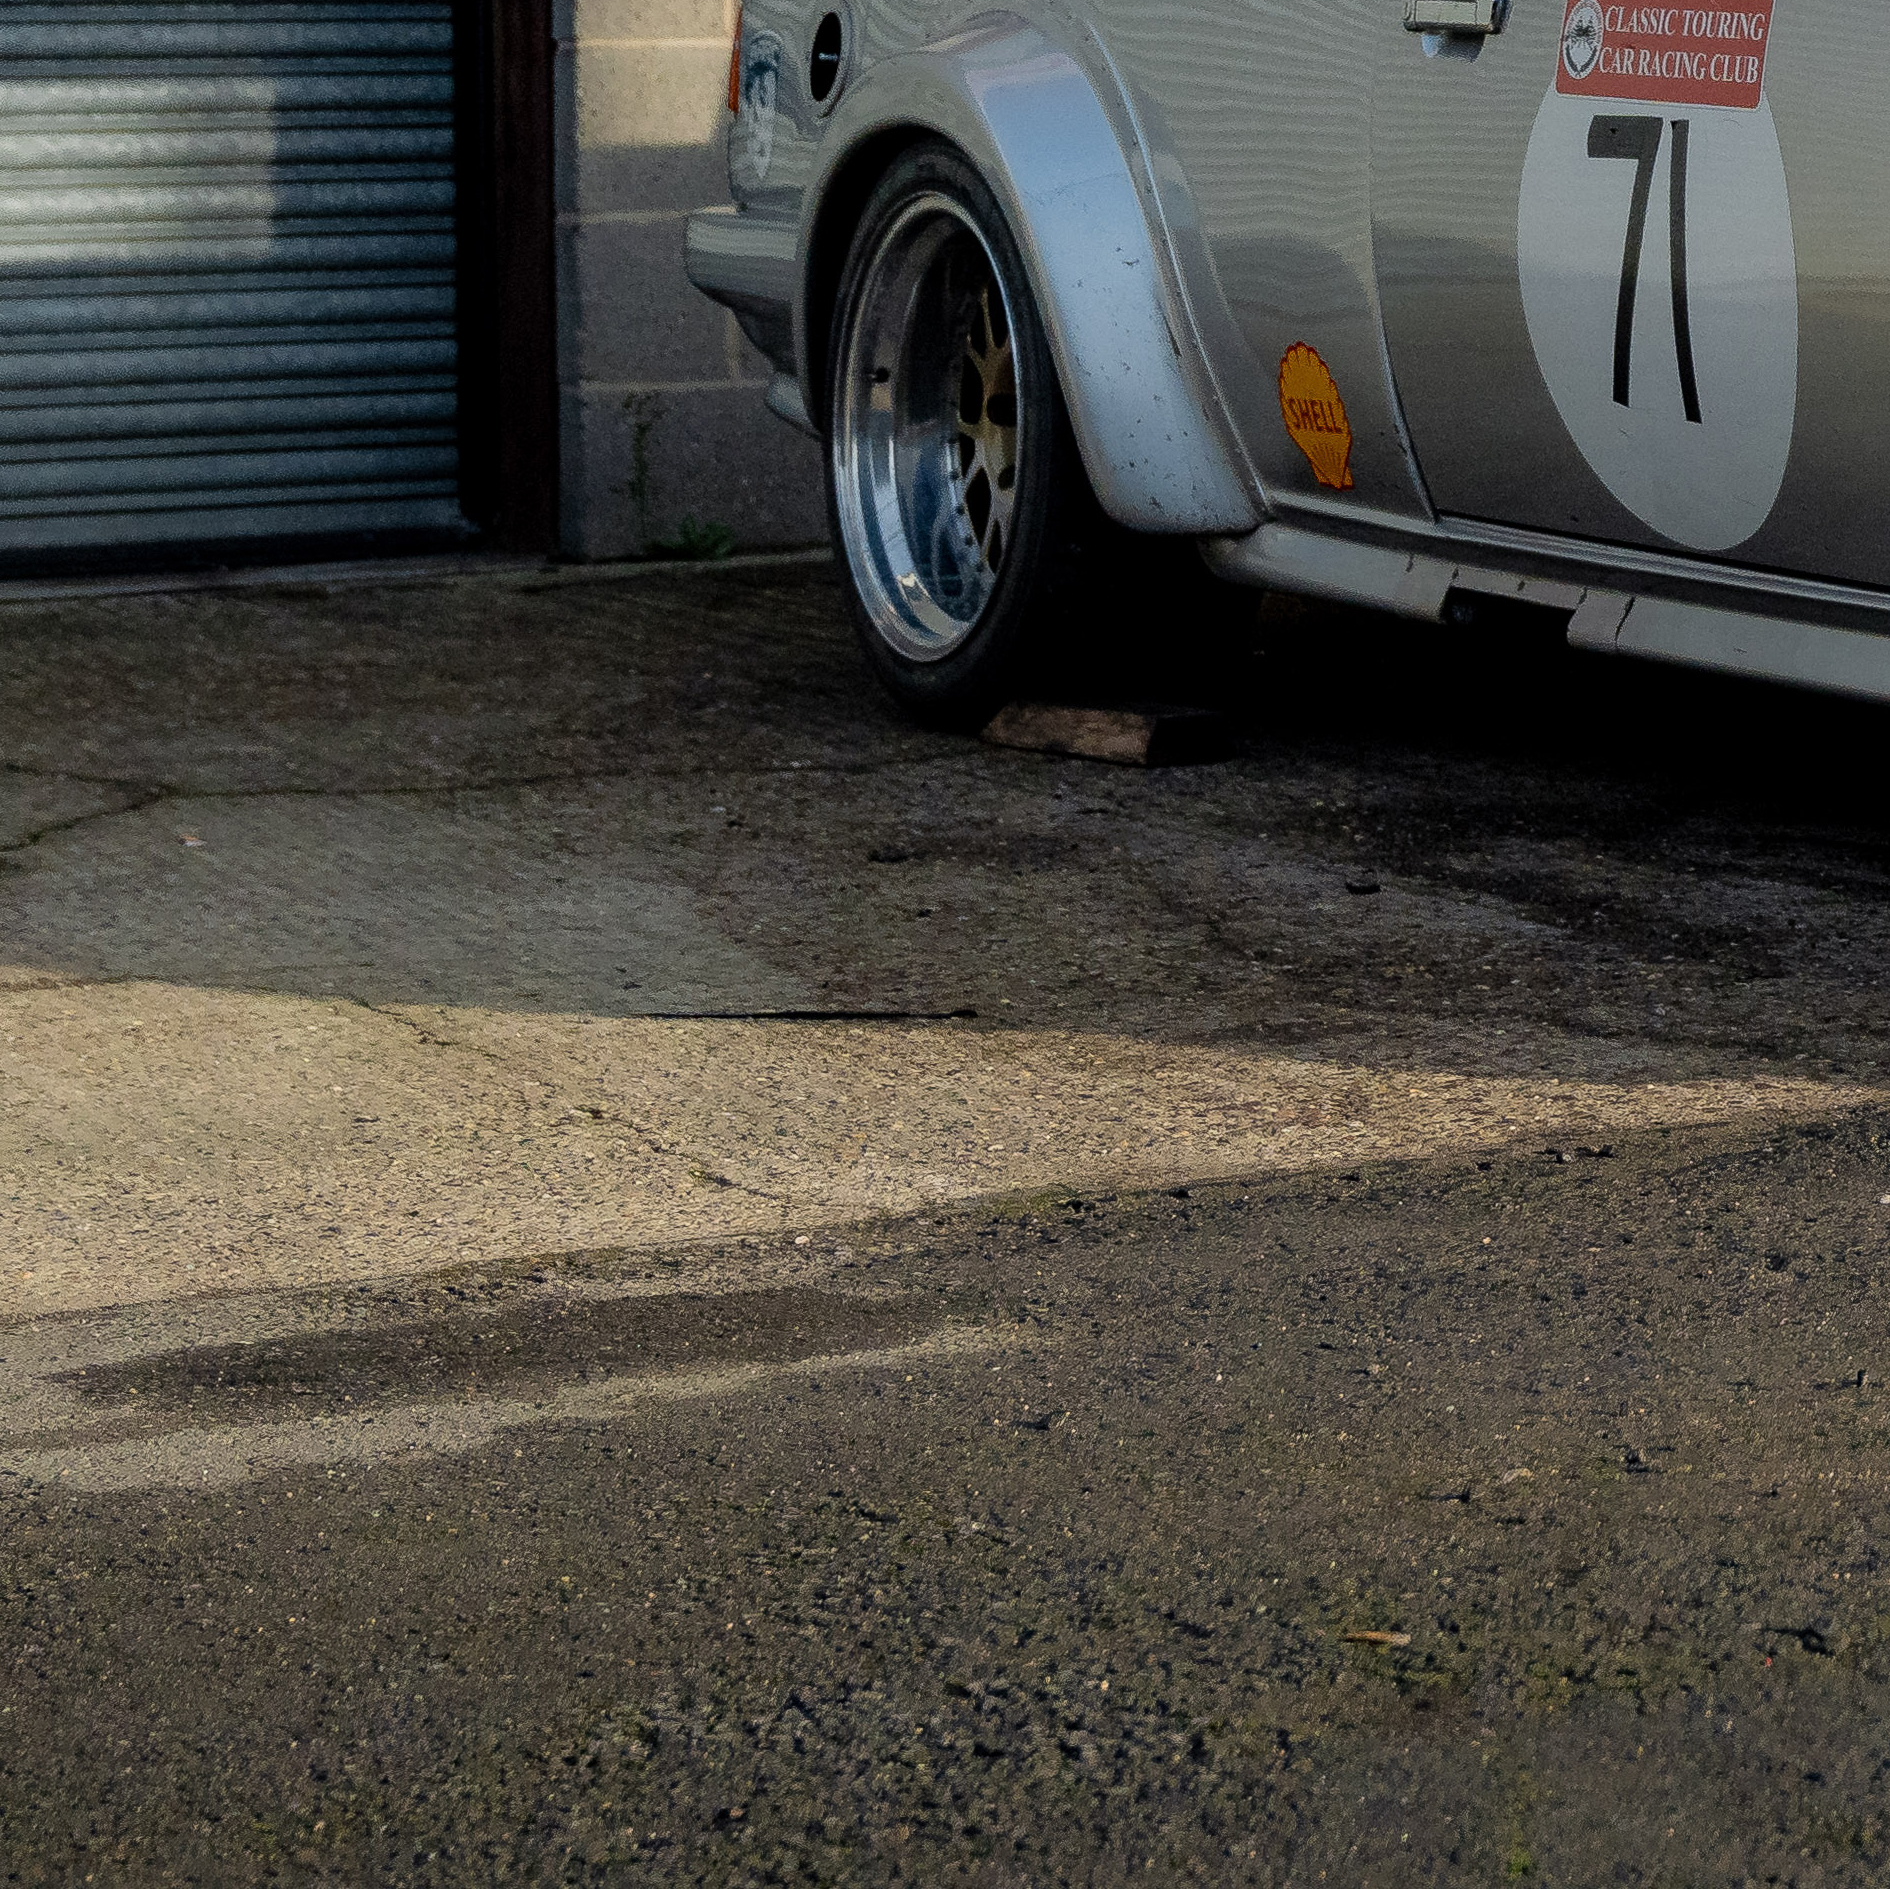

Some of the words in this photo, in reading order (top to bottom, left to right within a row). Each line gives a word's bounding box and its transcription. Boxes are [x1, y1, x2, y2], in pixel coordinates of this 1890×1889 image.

[1604, 4, 1679, 36] CLASSIC
[1681, 10, 1767, 41] TOURING
[1598, 46, 1636, 75] CAR
[1638, 48, 1709, 81] RACING
[1709, 52, 1760, 85] CLUB
[1586, 114, 1703, 425] 71
[1287, 397, 1344, 435] SHELL
